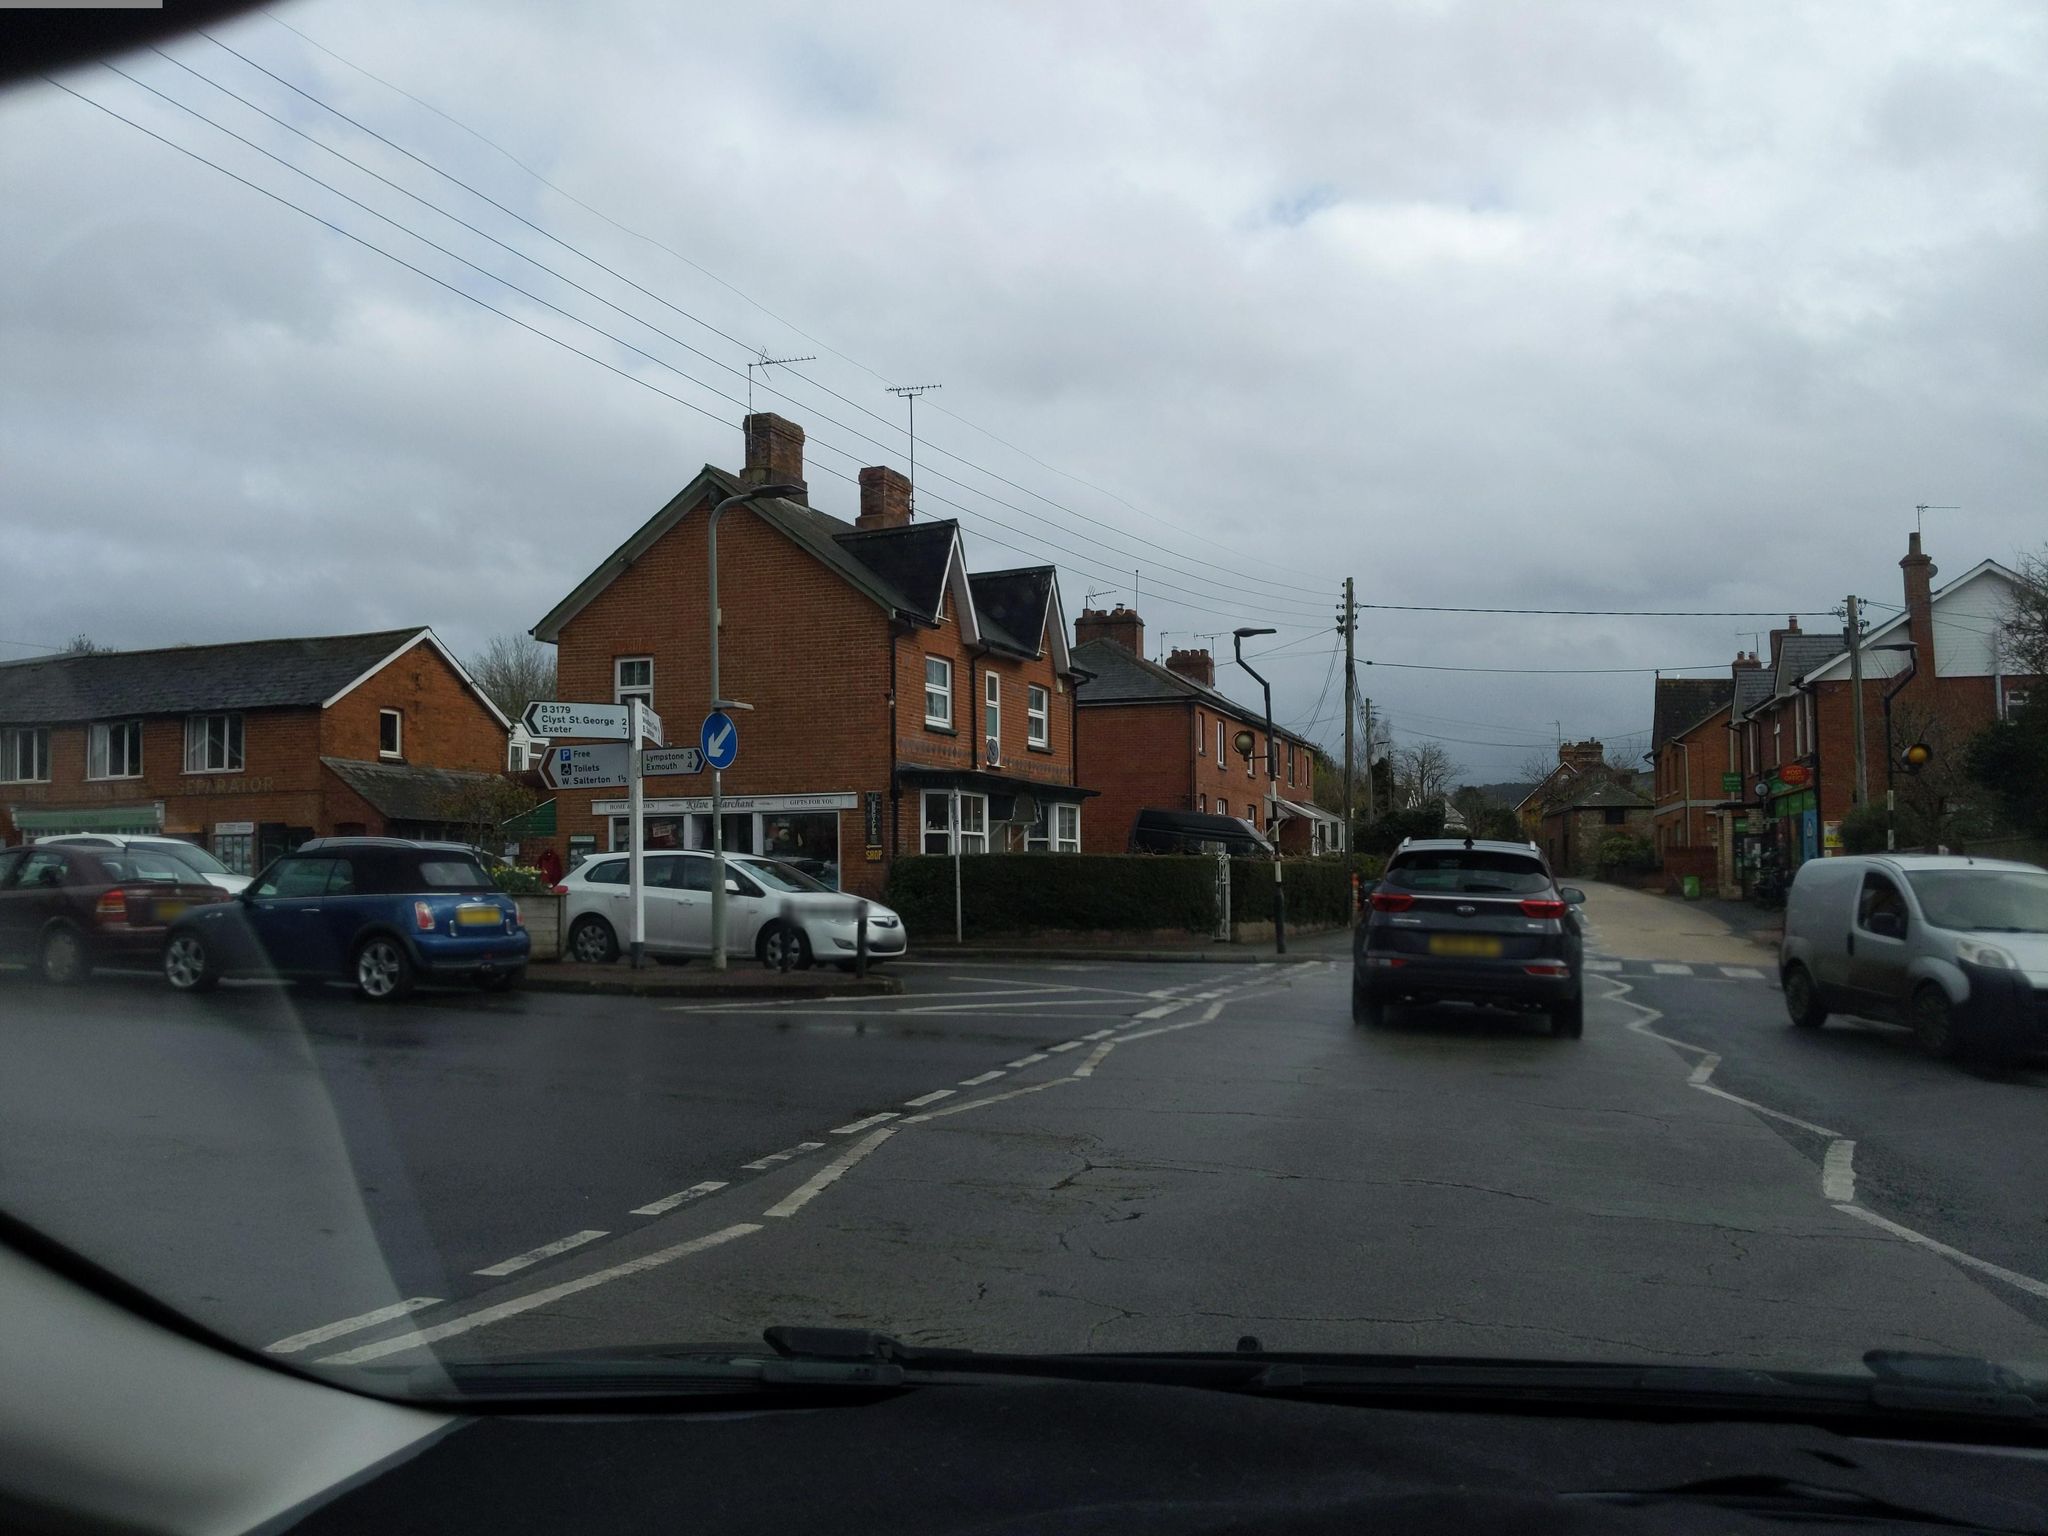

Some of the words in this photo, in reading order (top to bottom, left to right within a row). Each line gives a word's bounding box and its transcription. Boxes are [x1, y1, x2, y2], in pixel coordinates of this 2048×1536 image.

[542, 715, 566, 725] Clyst
[582, 717, 615, 726] George
[621, 718, 627, 726] 2
[542, 726, 572, 734] Exeter
[574, 750, 591, 758] Free
[646, 752, 684, 763] Lympstone
[574, 764, 600, 773] Toilets
[646, 762, 678, 770] Exmouth
[573, 776, 611, 784] Salterton
[176, 776, 274, 796] SEPARATOR
